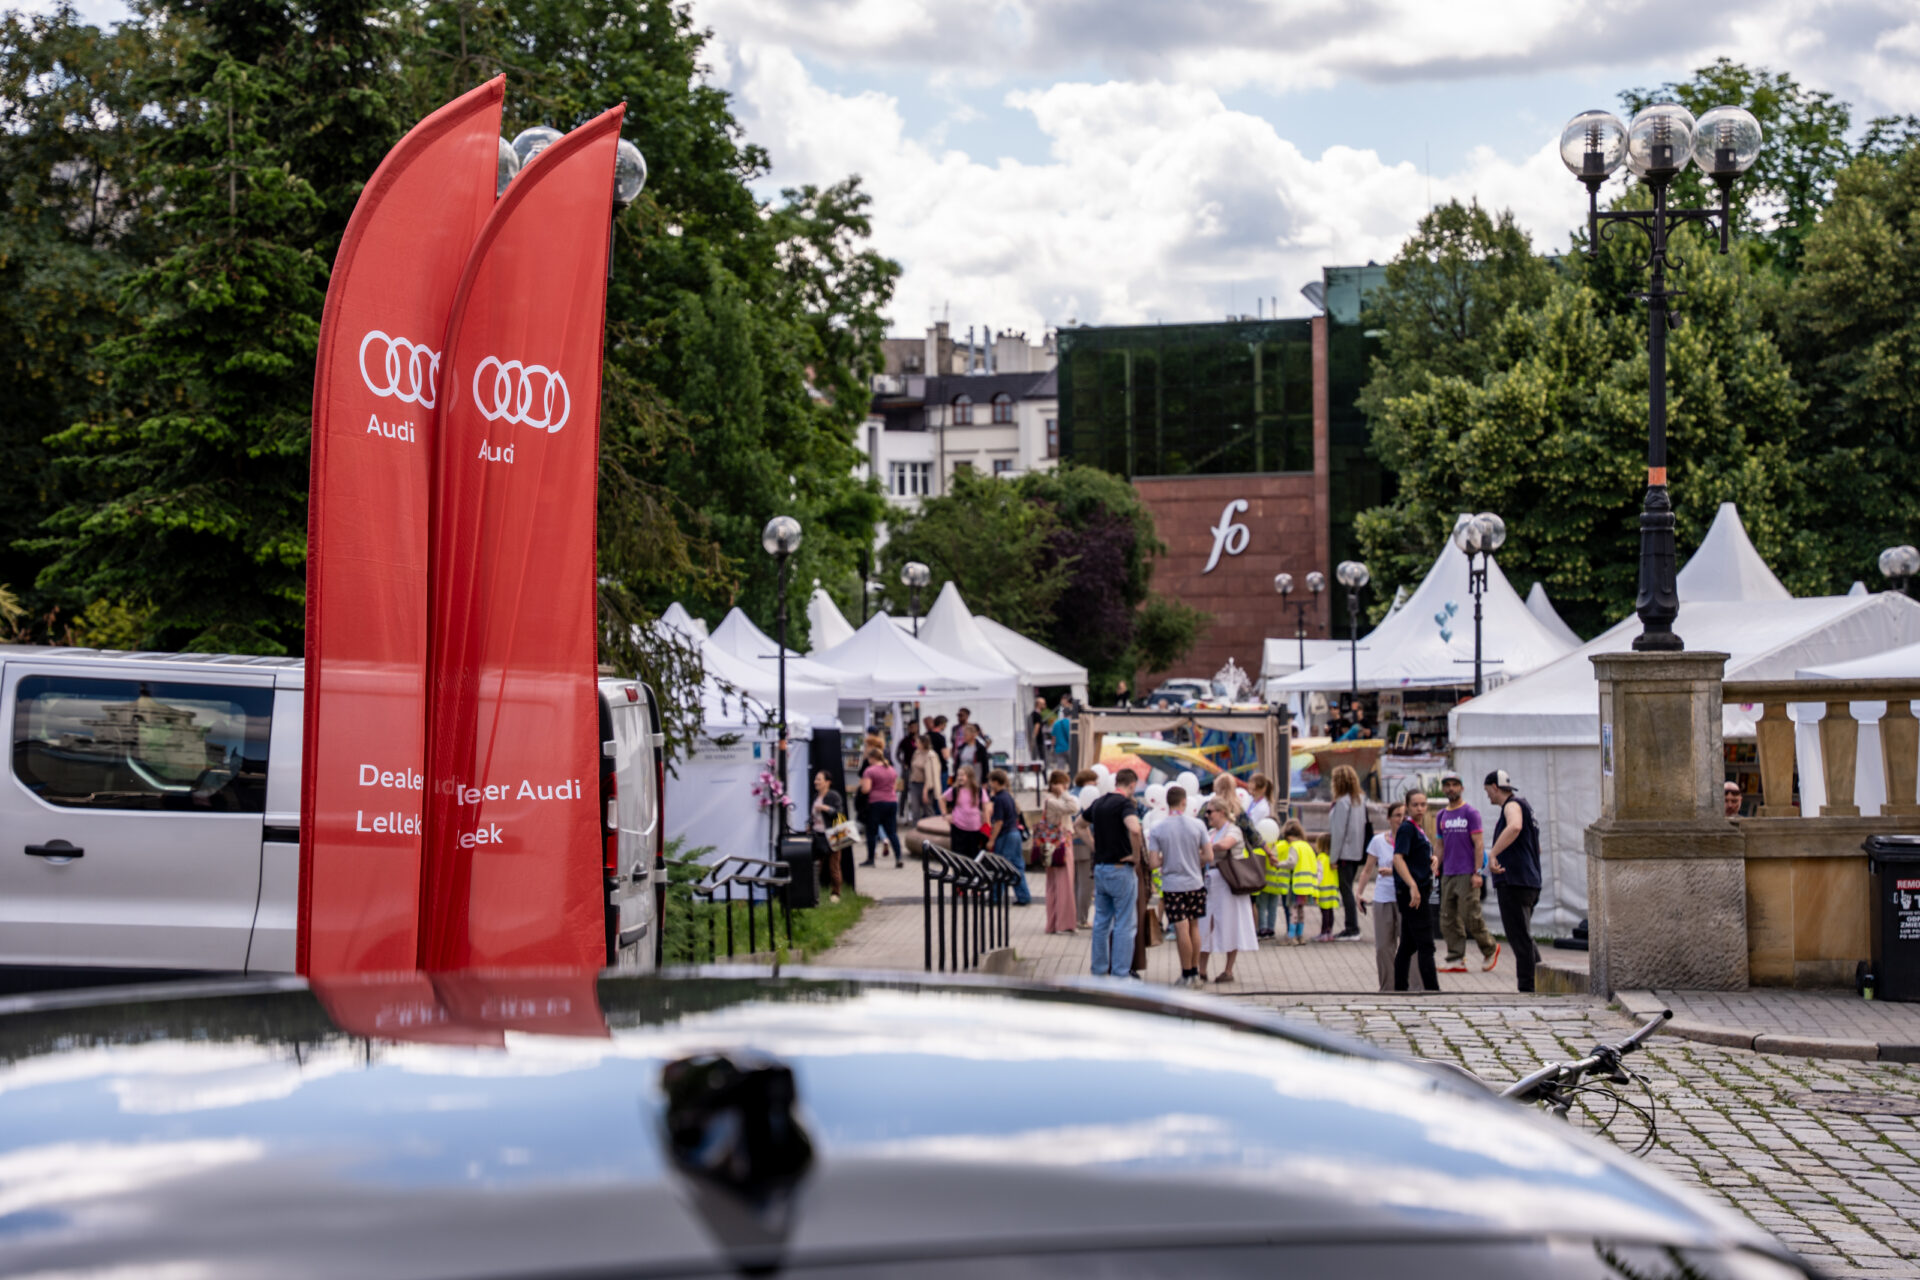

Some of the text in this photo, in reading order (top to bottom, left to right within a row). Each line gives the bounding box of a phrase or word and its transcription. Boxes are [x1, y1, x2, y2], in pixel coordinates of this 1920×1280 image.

[367, 413, 415, 443] Audi
[478, 439, 515, 464] Audi
[516, 779, 582, 800] Audi
[356, 809, 422, 836] Lellek
